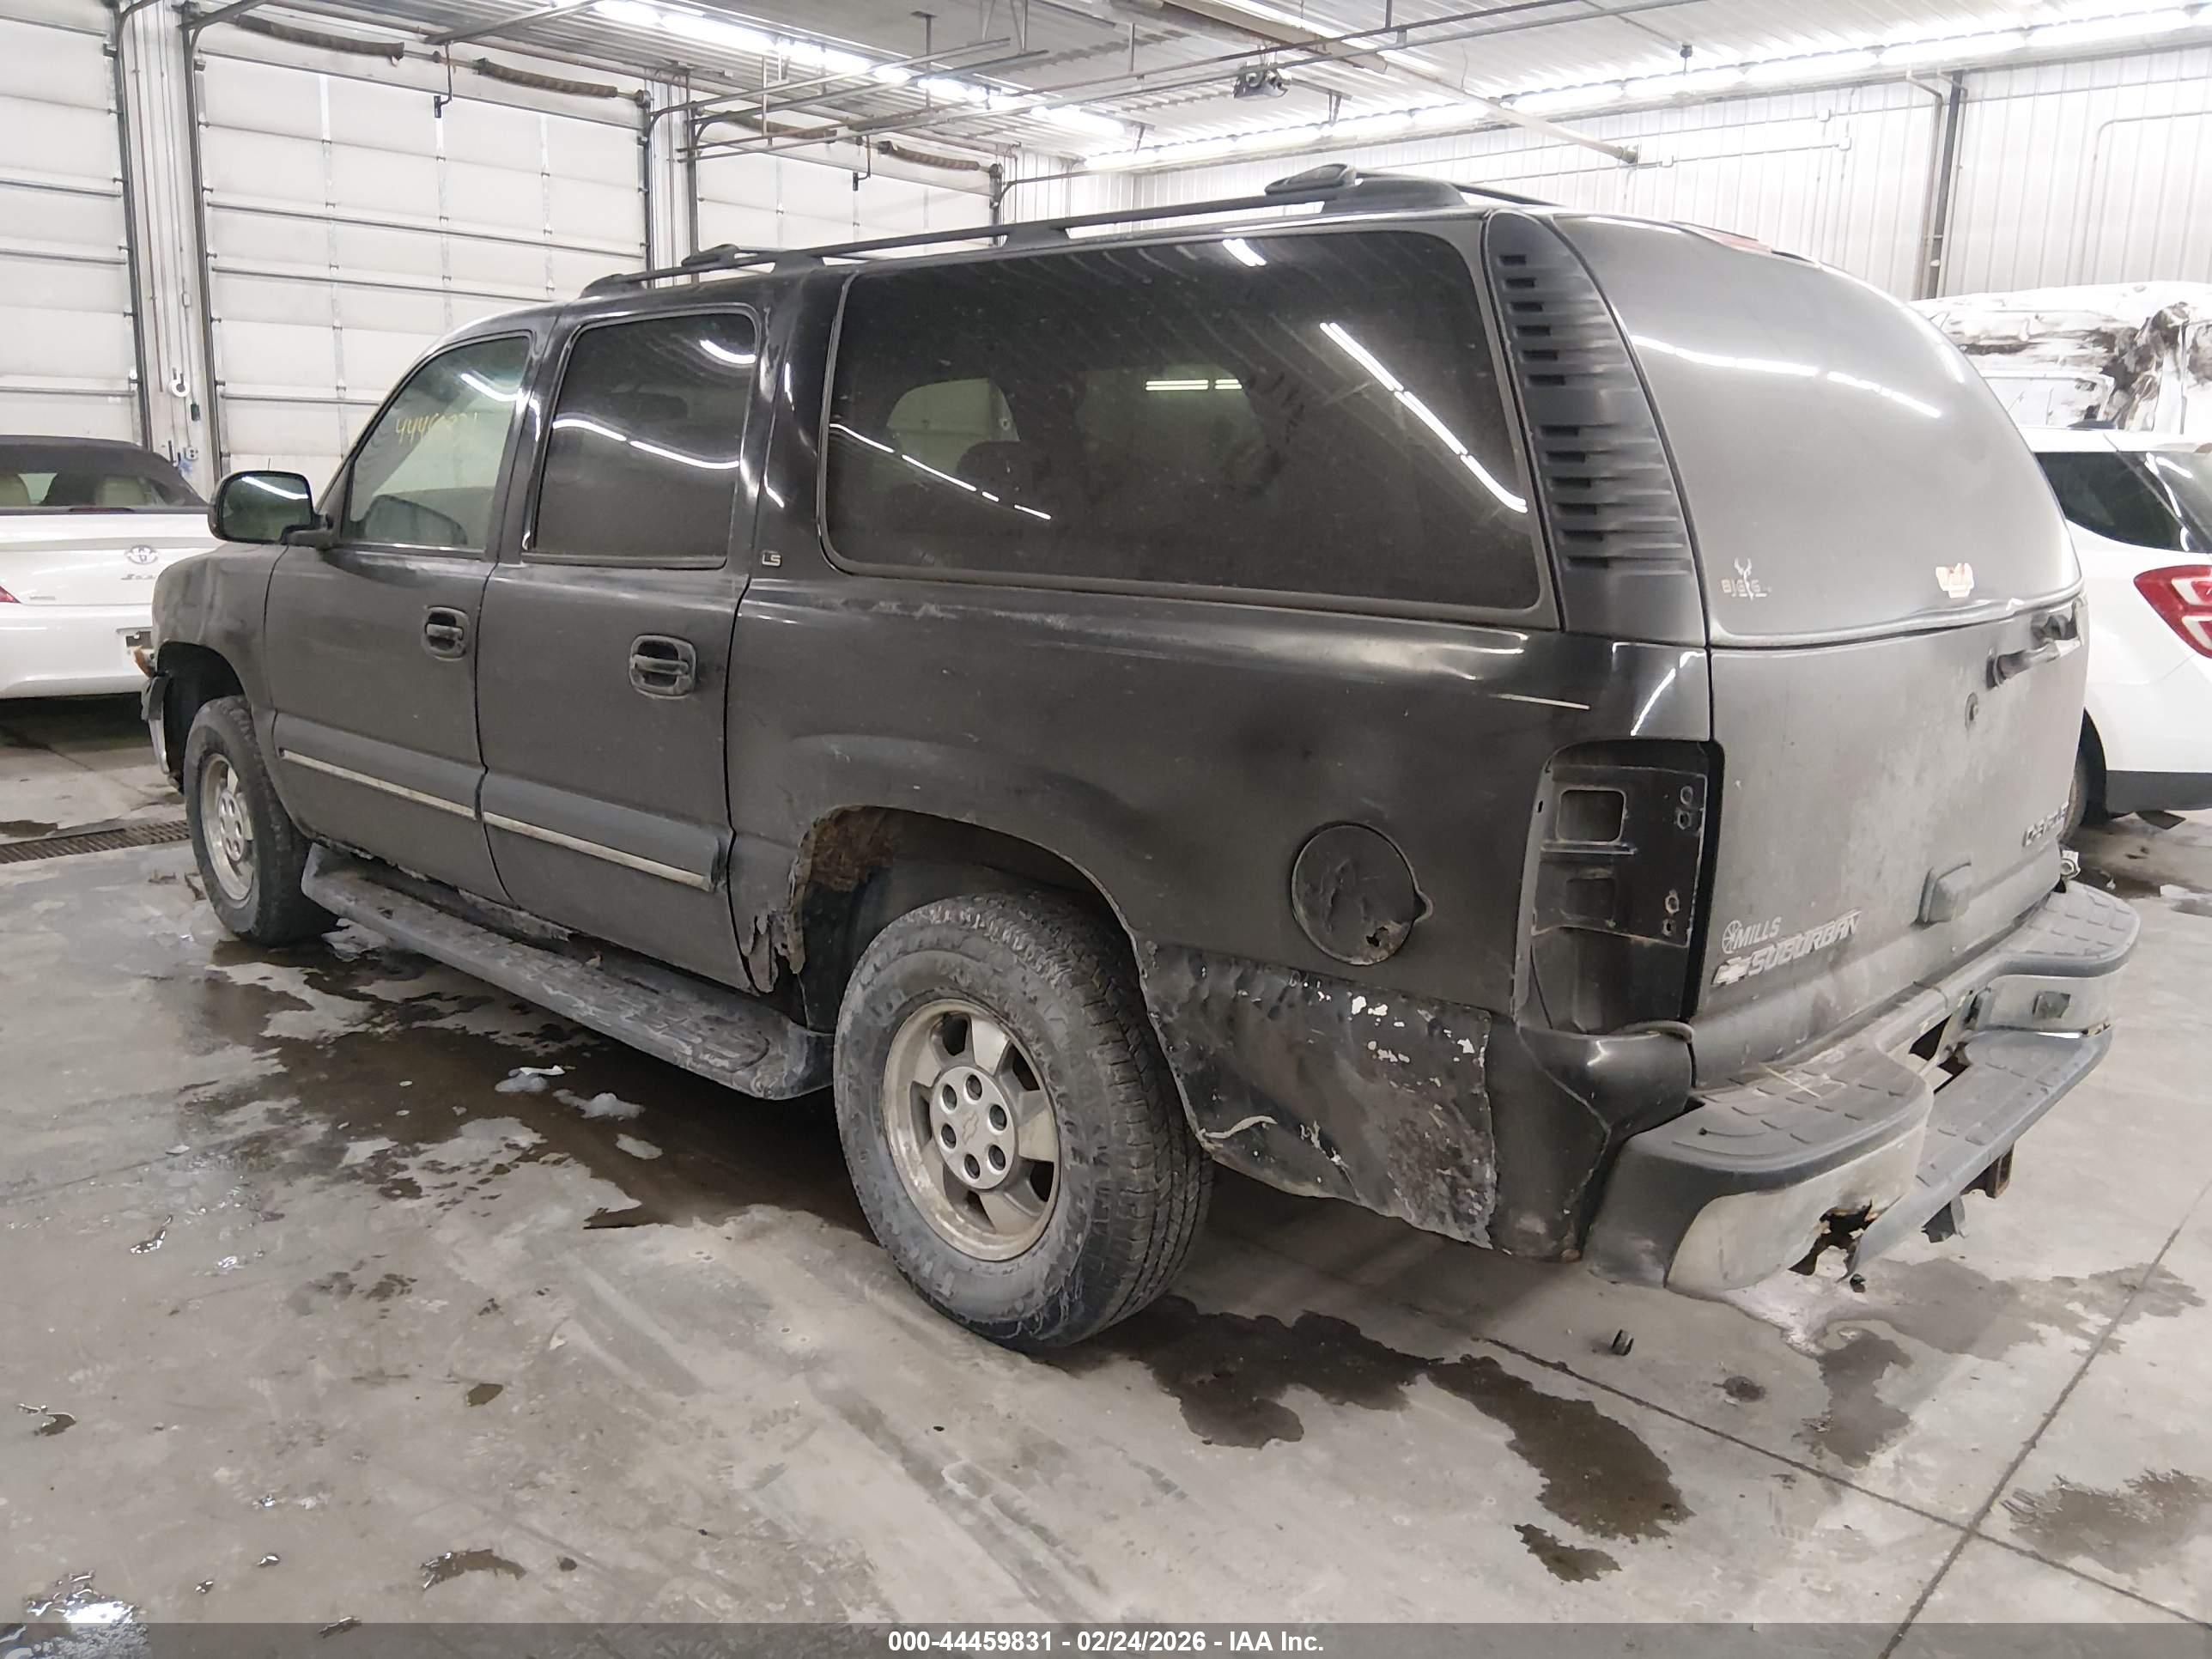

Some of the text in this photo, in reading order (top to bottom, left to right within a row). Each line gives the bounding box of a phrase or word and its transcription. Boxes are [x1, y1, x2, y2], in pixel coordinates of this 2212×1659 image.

[762, 554, 781, 567] LS
[1733, 916, 1783, 950] MILLS
[1747, 908, 1863, 976] SUBURBAN
